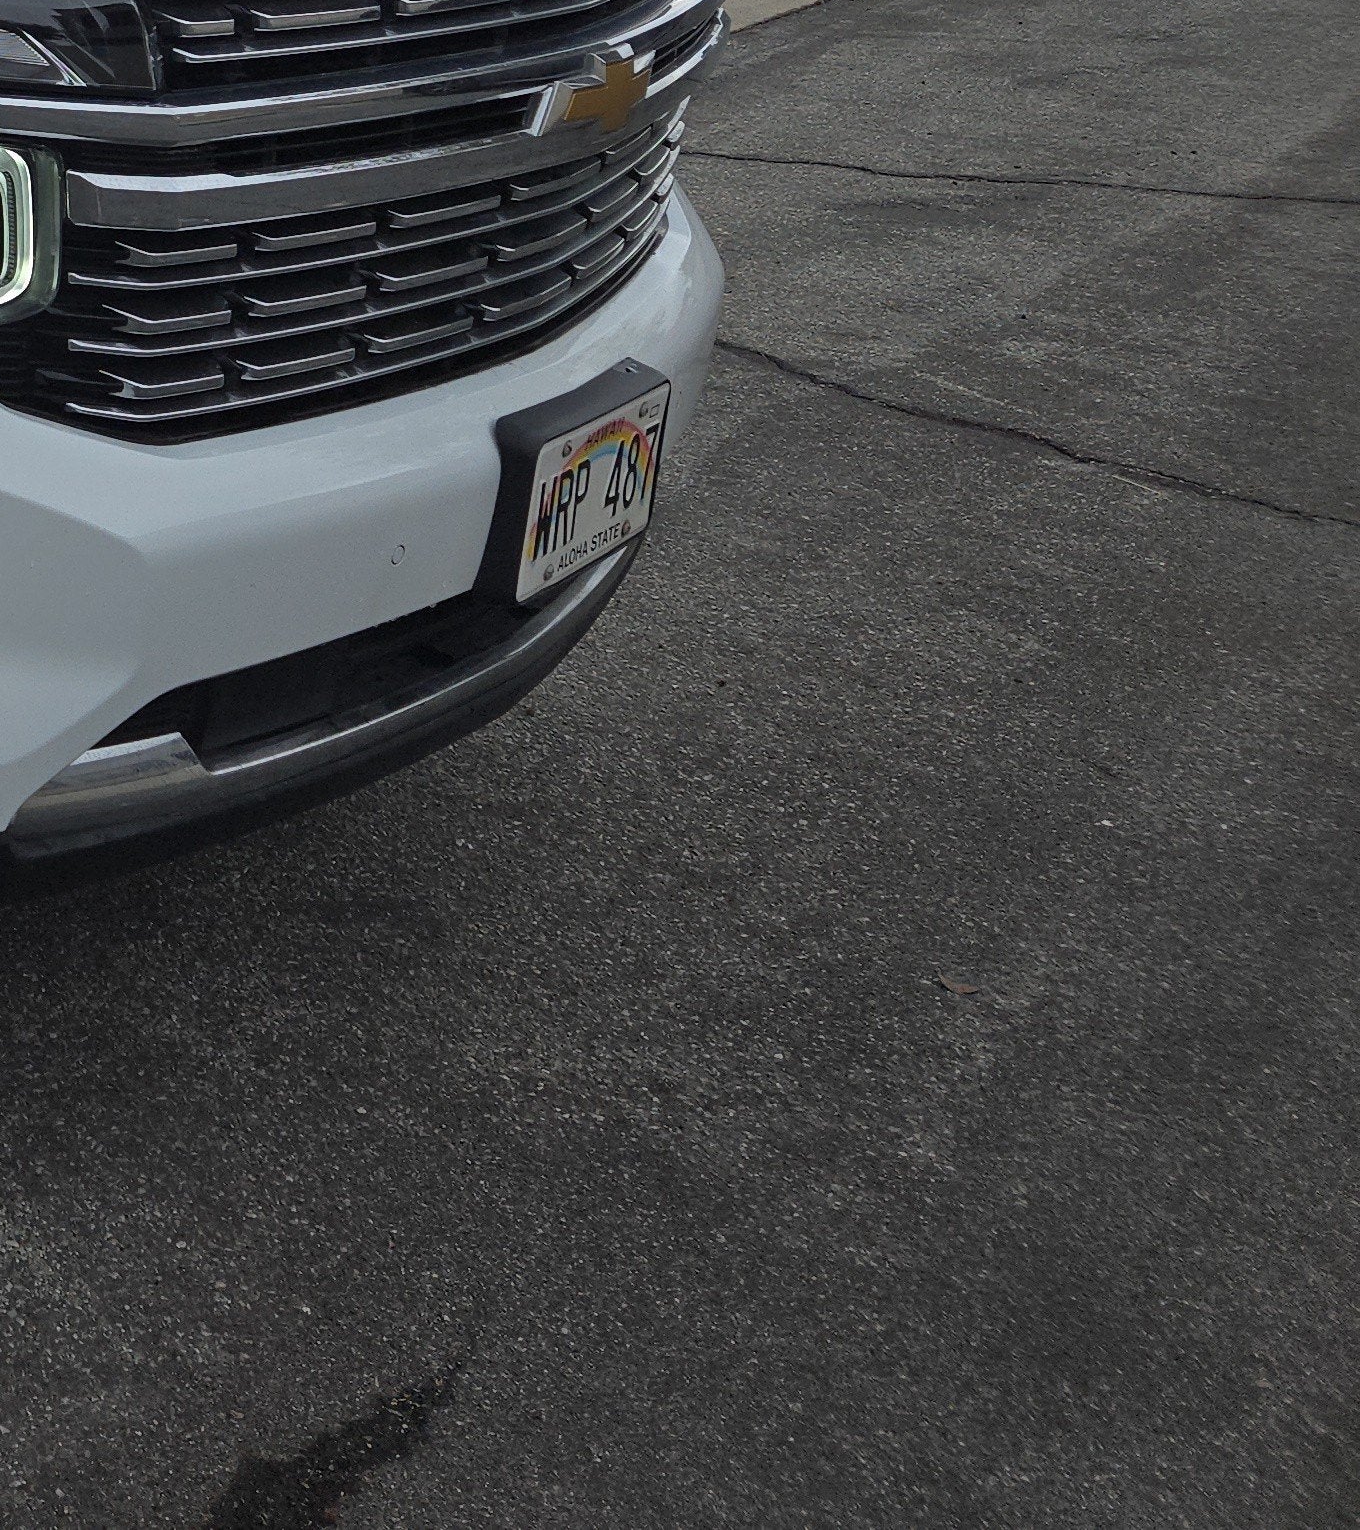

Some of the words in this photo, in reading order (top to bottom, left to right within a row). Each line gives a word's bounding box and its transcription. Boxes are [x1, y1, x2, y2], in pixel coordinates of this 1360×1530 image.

[532, 459, 591, 562] WRP
[603, 422, 660, 517] 487
[557, 540, 588, 572] ALOHA
[590, 522, 622, 553] STATE
